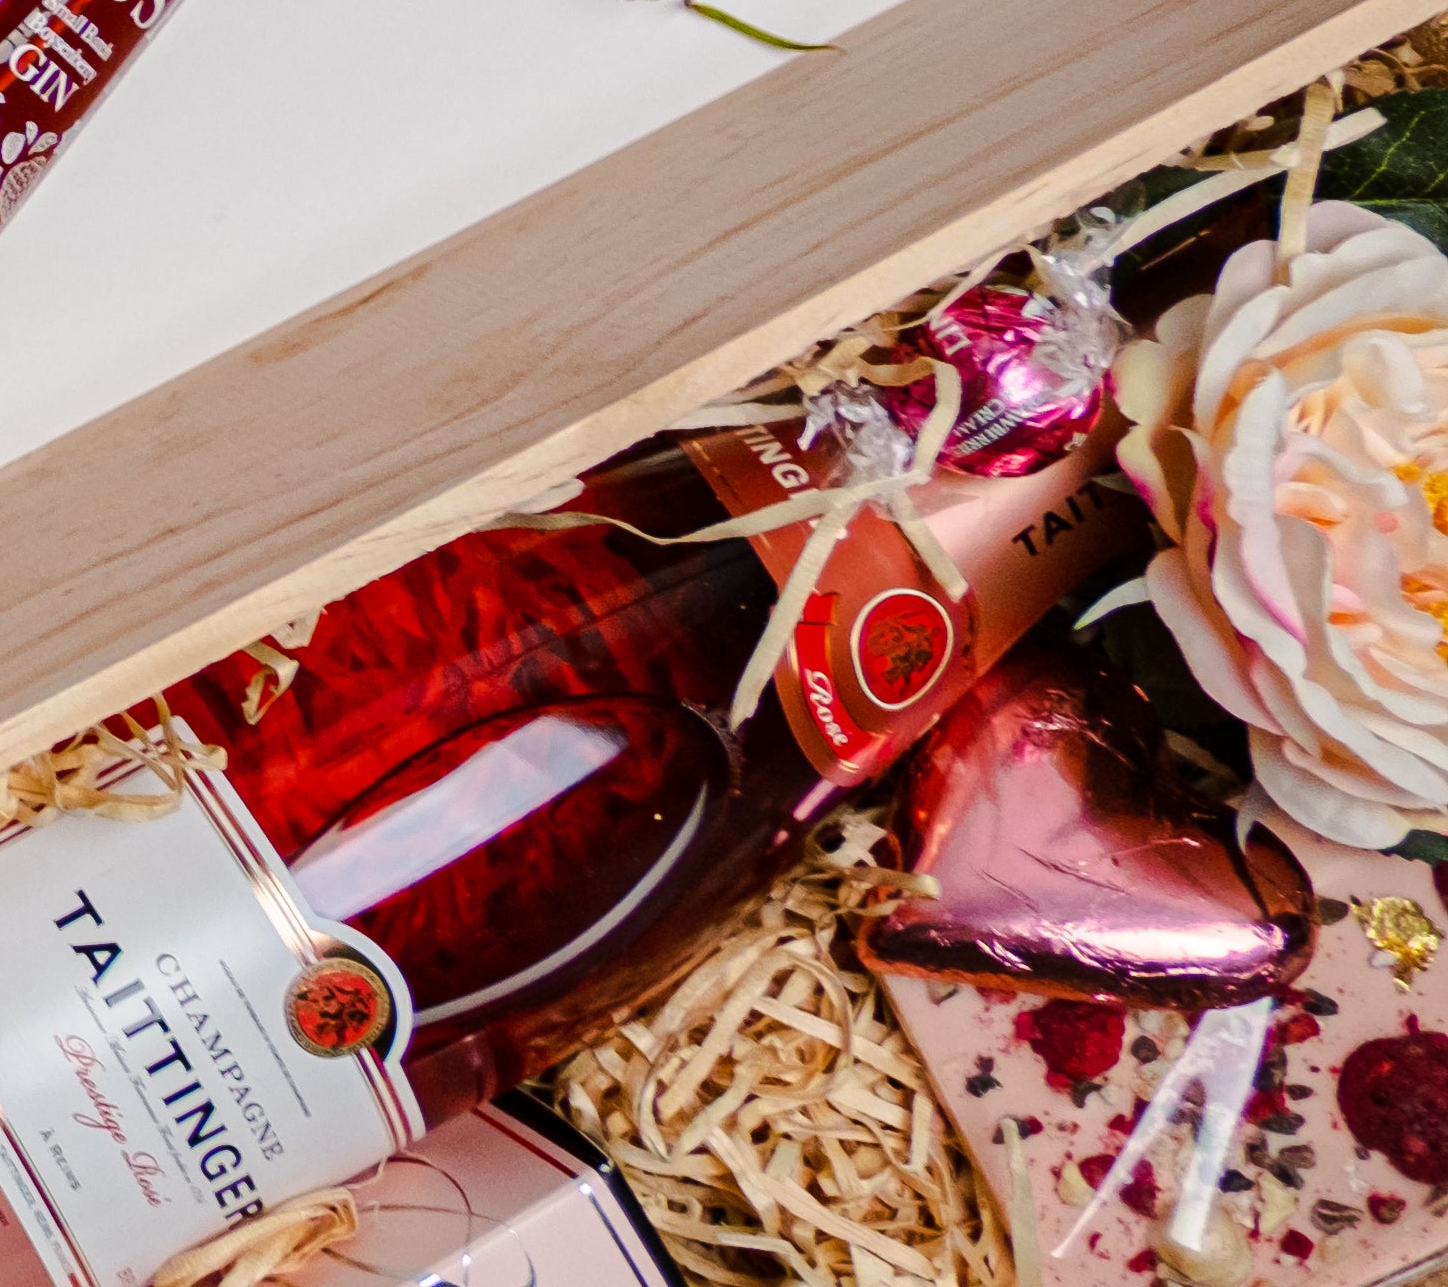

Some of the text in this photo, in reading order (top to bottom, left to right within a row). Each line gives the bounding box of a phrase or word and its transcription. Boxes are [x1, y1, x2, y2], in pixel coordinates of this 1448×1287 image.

[9, 44, 79, 112] GIN
[54, 888, 266, 1231] TAITTINGER
[54, 1033, 129, 1145] Prestige
[156, 953, 284, 1162] CHAMPAGNE
